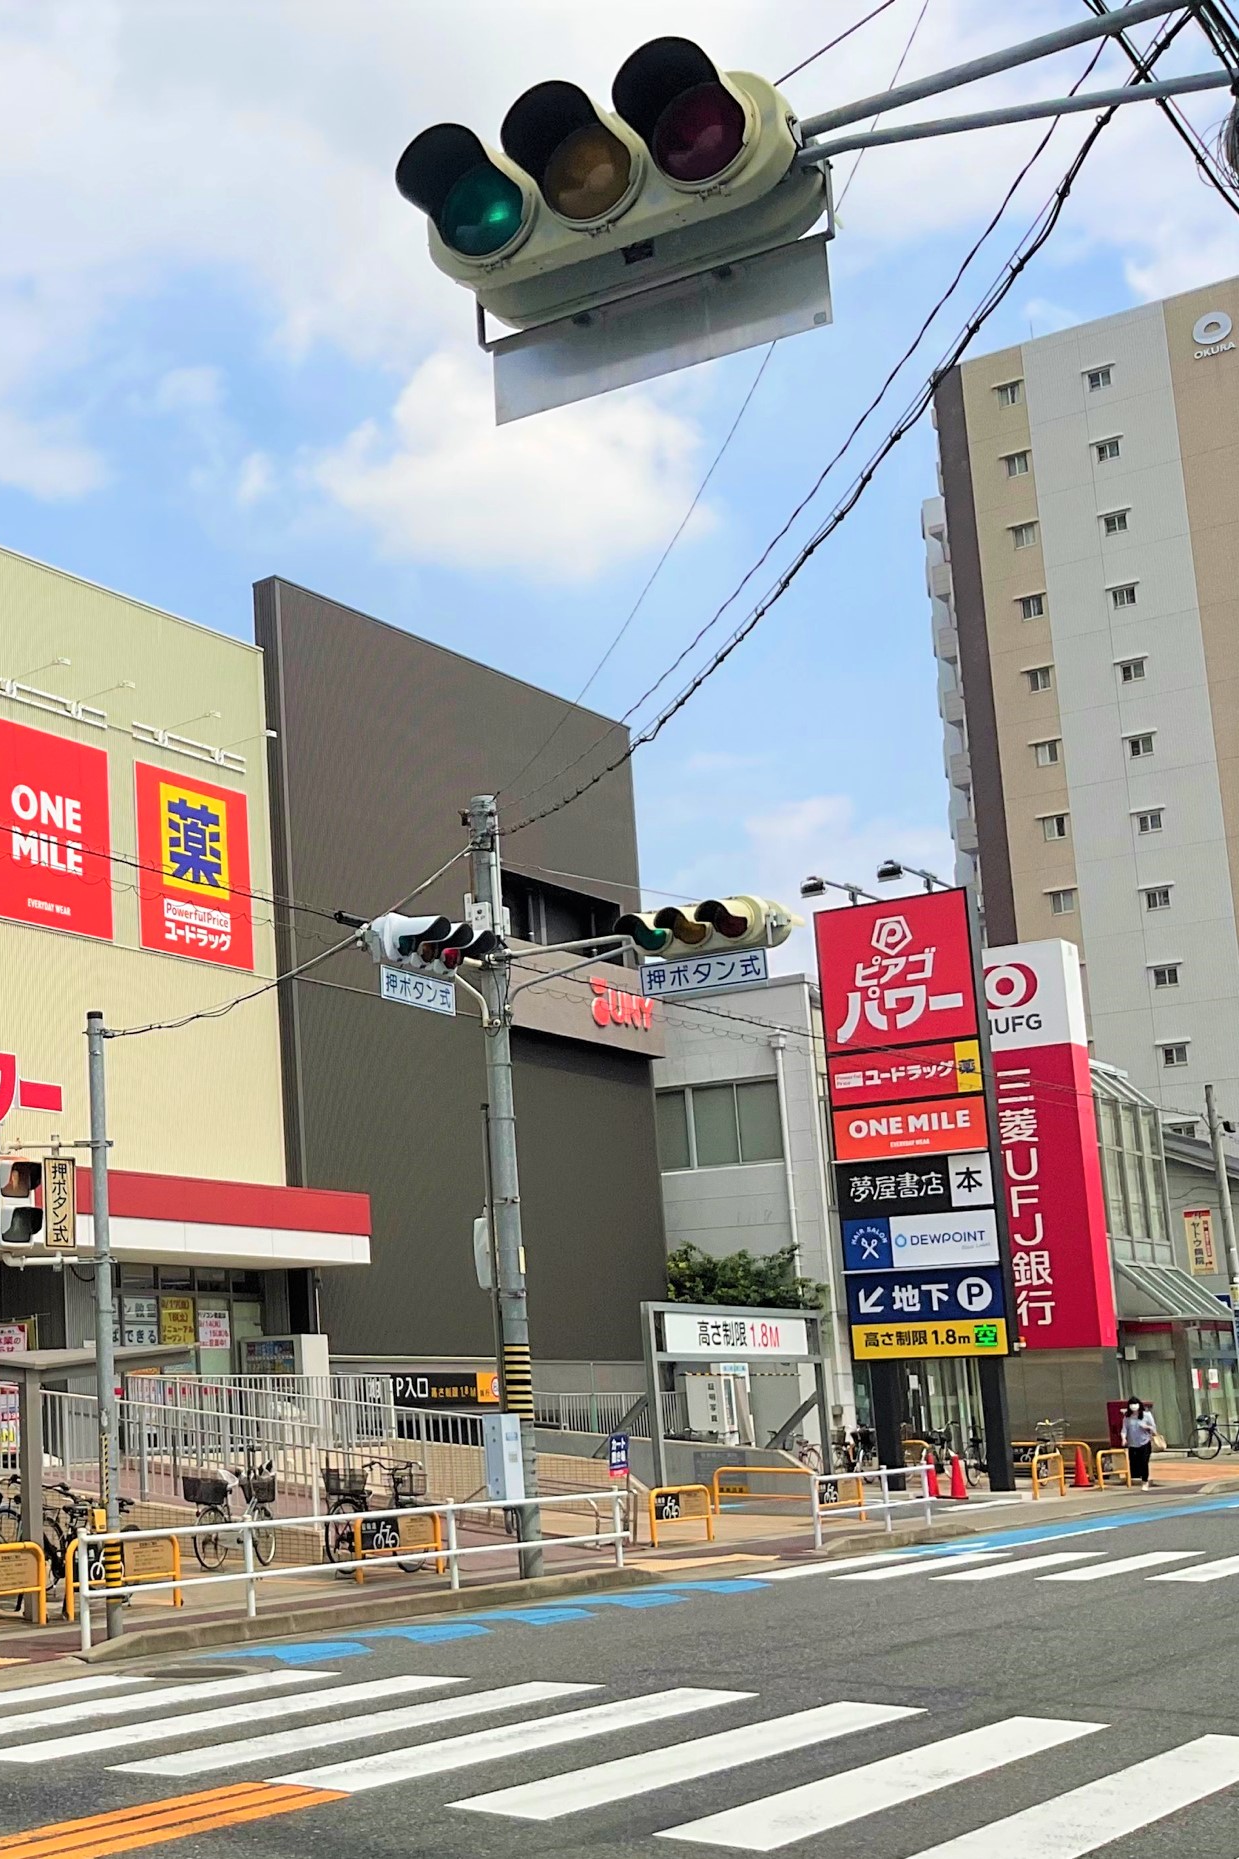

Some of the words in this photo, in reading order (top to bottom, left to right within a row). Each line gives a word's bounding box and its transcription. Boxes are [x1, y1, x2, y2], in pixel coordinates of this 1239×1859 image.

[1194, 341, 1236, 360] OKURA
[11, 784, 82, 834] ONE
[11, 825, 83, 876] MILE
[167, 797, 222, 887] 薬
[27, 898, 55, 913] EVERYDAY
[55, 902, 71, 916] WEAR
[165, 921, 231, 951] ユードラッグ
[646, 952, 761, 990] 押ボタン式
[855, 947, 936, 987] ピアゴ
[385, 972, 452, 1010] 押ボタン式
[837, 985, 963, 1043] パワー
[991, 1013, 1042, 1035] UFG
[865, 1060, 954, 1085] ユードラッグ
[849, 1116, 903, 1138] ONE
[907, 1109, 971, 1133] MILE
[849, 1172, 944, 1202] 夢屋書店
[955, 1167, 983, 1193] 本
[997, 1068, 1055, 1326] 三菱UFJ銀行
[51, 1163, 69, 1243] 押ボタン式
[851, 1228, 864, 1245] HAIR
[866, 1226, 888, 1244] SALON
[910, 1230, 986, 1246] DEWPOINT
[892, 1283, 949, 1312] 地下
[966, 1283, 984, 1306] P
[697, 1320, 747, 1346] 高さ制限
[750, 1323, 780, 1347] 1.8M
[864, 1330, 928, 1347] 高さ制限
[931, 1329, 970, 1345] 1.8m
[973, 1324, 998, 1347] 空
